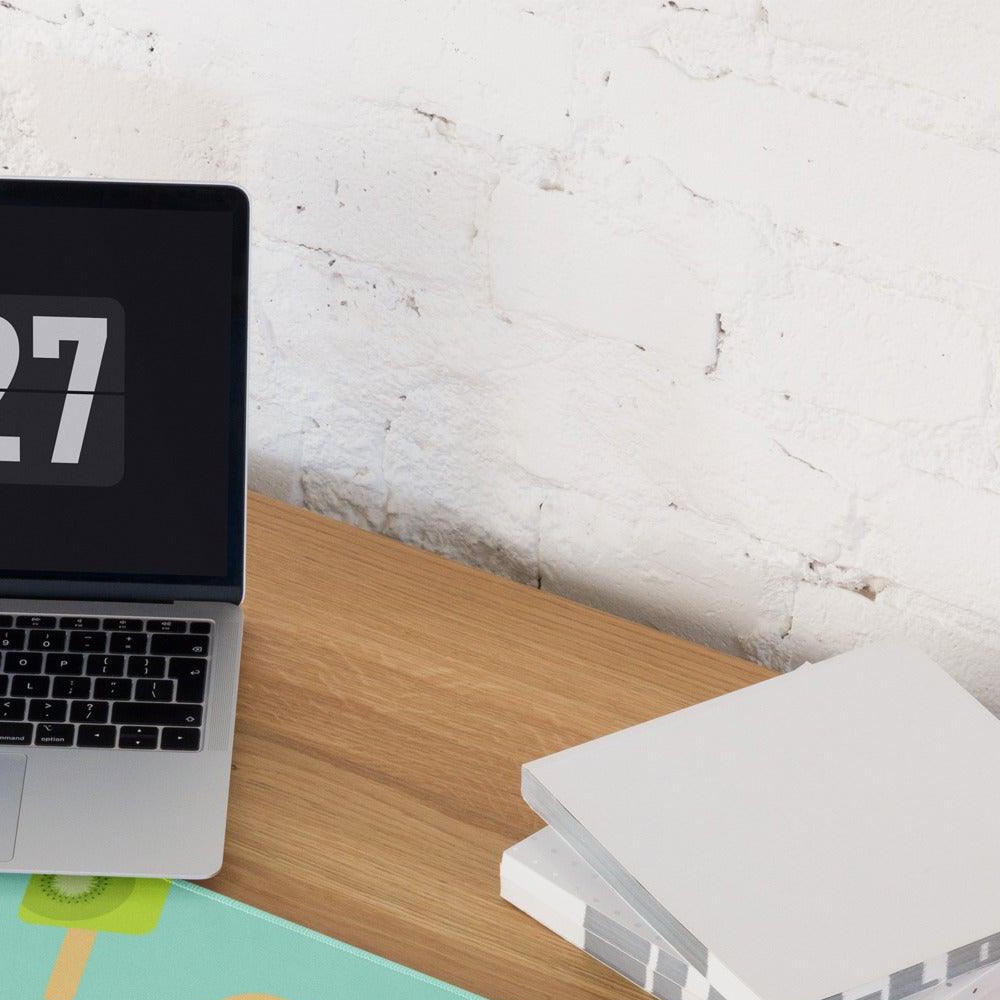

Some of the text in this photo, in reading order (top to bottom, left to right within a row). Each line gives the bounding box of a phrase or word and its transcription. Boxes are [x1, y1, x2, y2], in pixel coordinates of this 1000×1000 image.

[42, 640, 51, 648] 0
[18, 658, 28, 666] O
[26, 682, 33, 690] L
